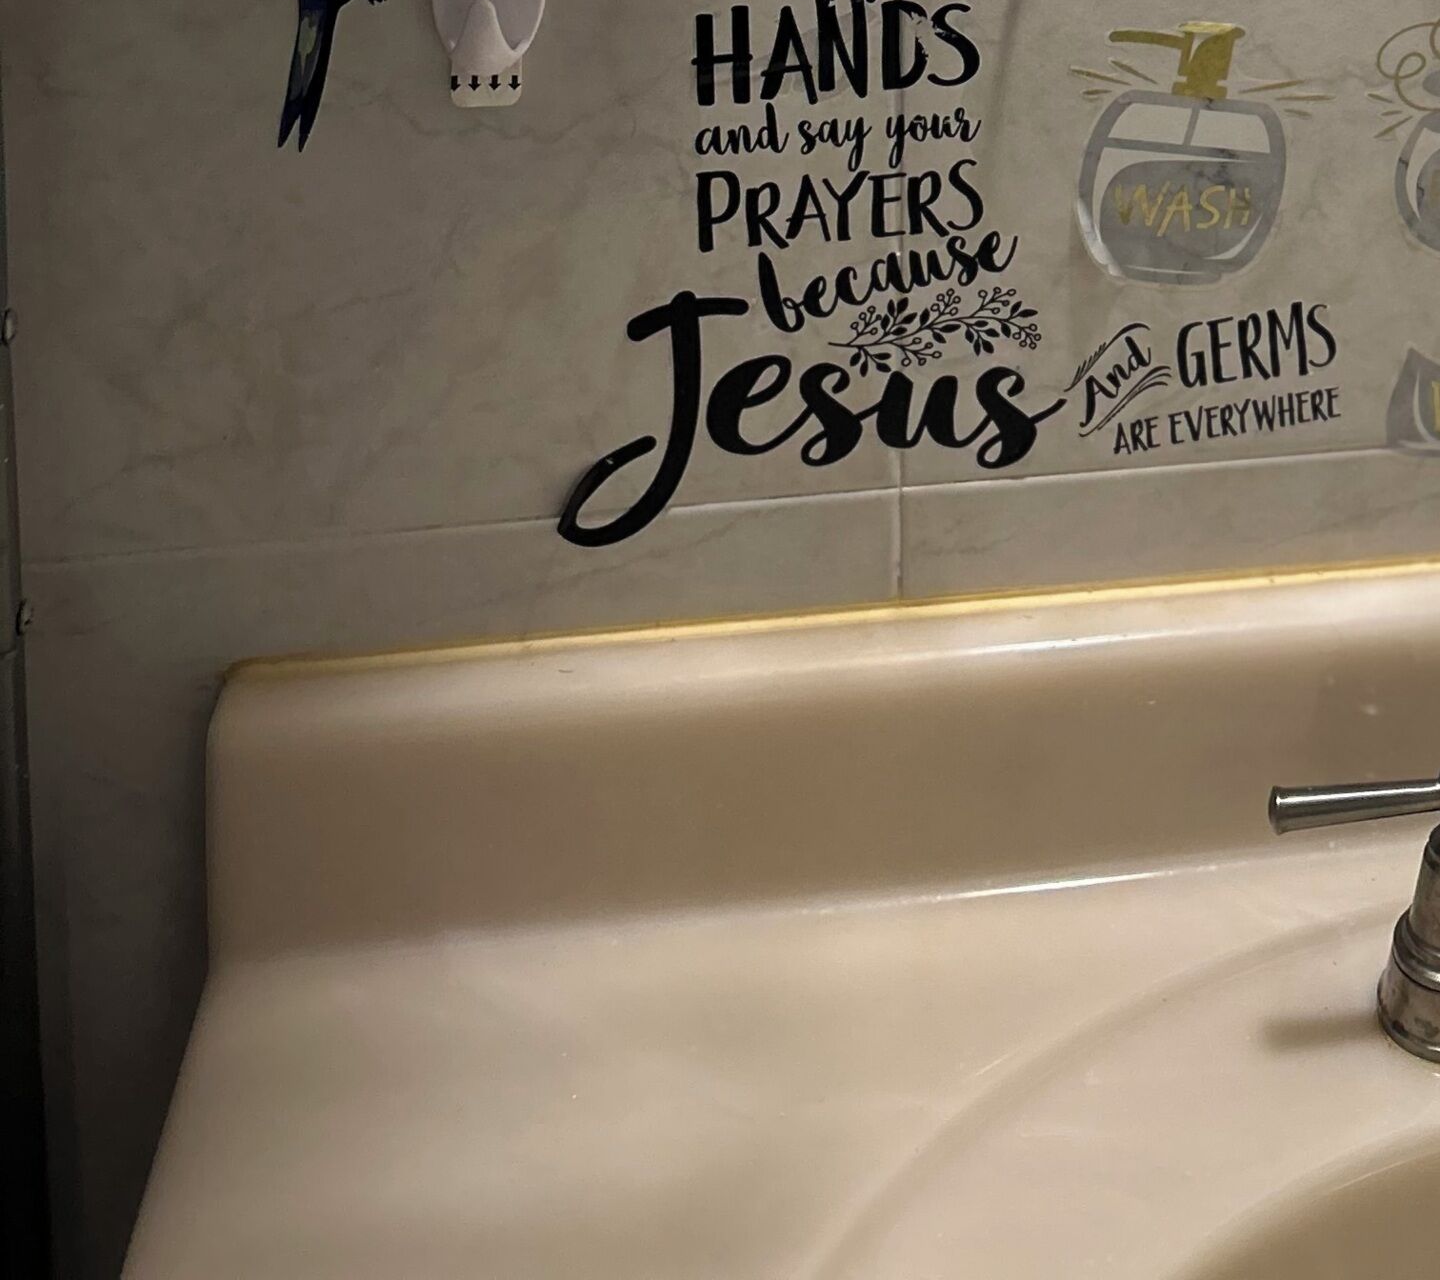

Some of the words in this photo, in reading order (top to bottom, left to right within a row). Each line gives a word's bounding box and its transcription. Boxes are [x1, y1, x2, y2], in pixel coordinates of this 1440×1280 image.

[694, 103, 789, 155] and
[798, 114, 871, 172] say
[883, 105, 982, 167] your
[694, 158, 985, 253] PRAYERS
[1114, 181, 1253, 238] WASH
[757, 230, 1018, 334] because
[1080, 330, 1152, 427] And
[1176, 301, 1338, 389] GERMS
[556, 290, 1066, 547] Jesus
[1112, 415, 1160, 455] ARE
[1169, 386, 1342, 446] EVERYWHERE
